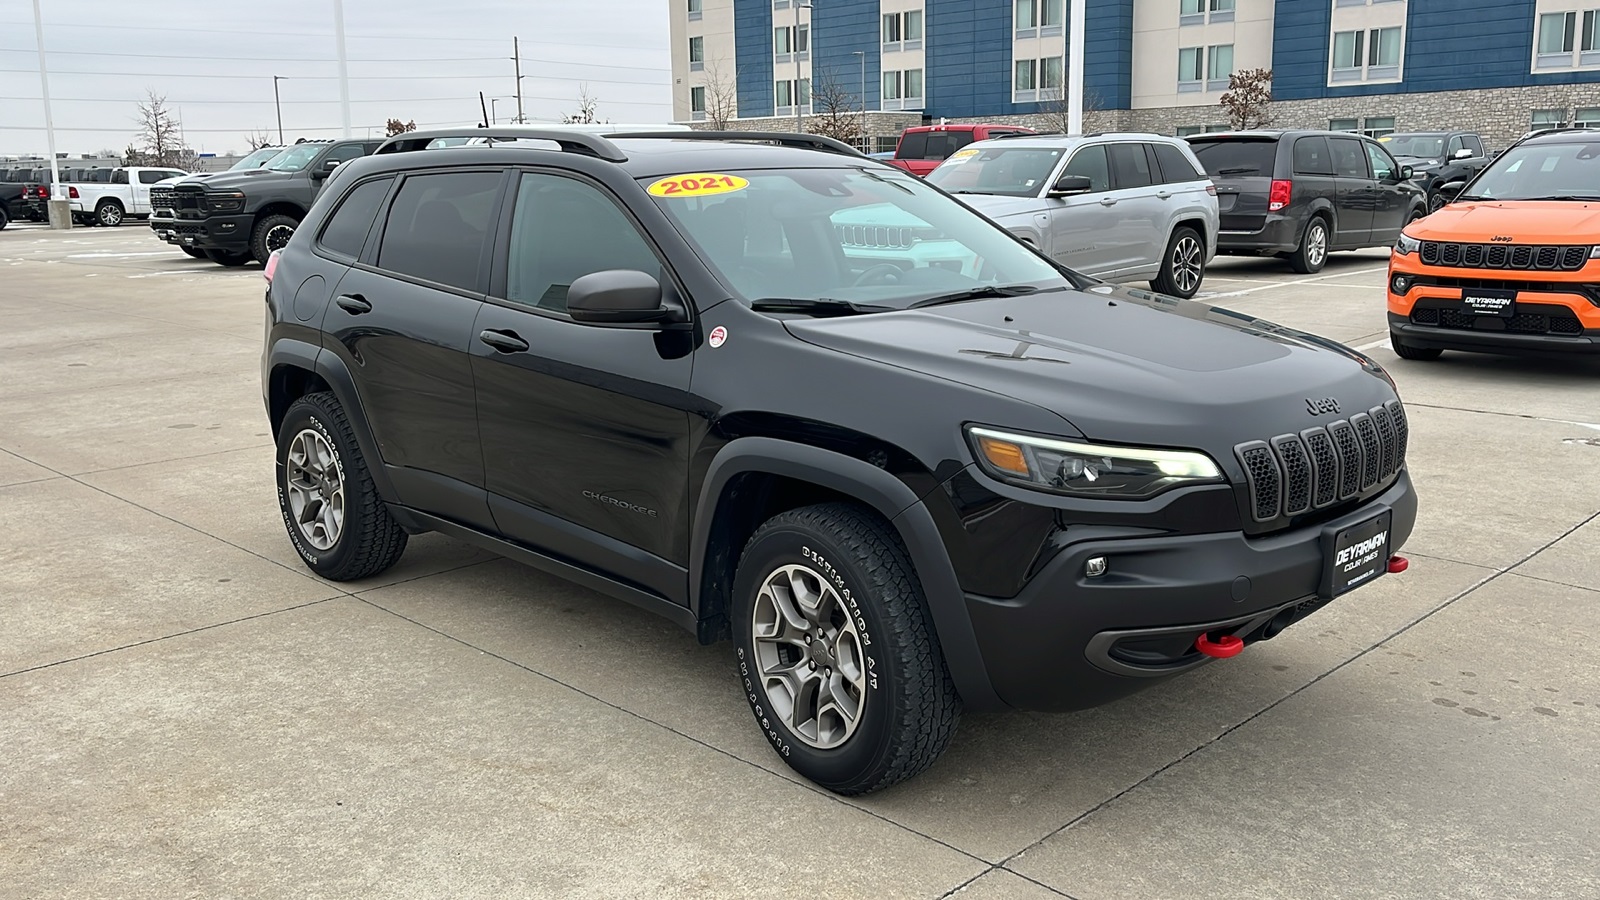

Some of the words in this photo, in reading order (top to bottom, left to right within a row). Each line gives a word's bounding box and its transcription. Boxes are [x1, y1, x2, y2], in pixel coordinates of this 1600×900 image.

[660, 176, 735, 195] 2021
[1464, 296, 1512, 306] DEYARMAN
[1304, 398, 1341, 416] Jeep
[582, 490, 657, 517] CHEROKEE
[1335, 530, 1388, 567] DEYARMAN
[802, 546, 872, 646] DESTINATION
